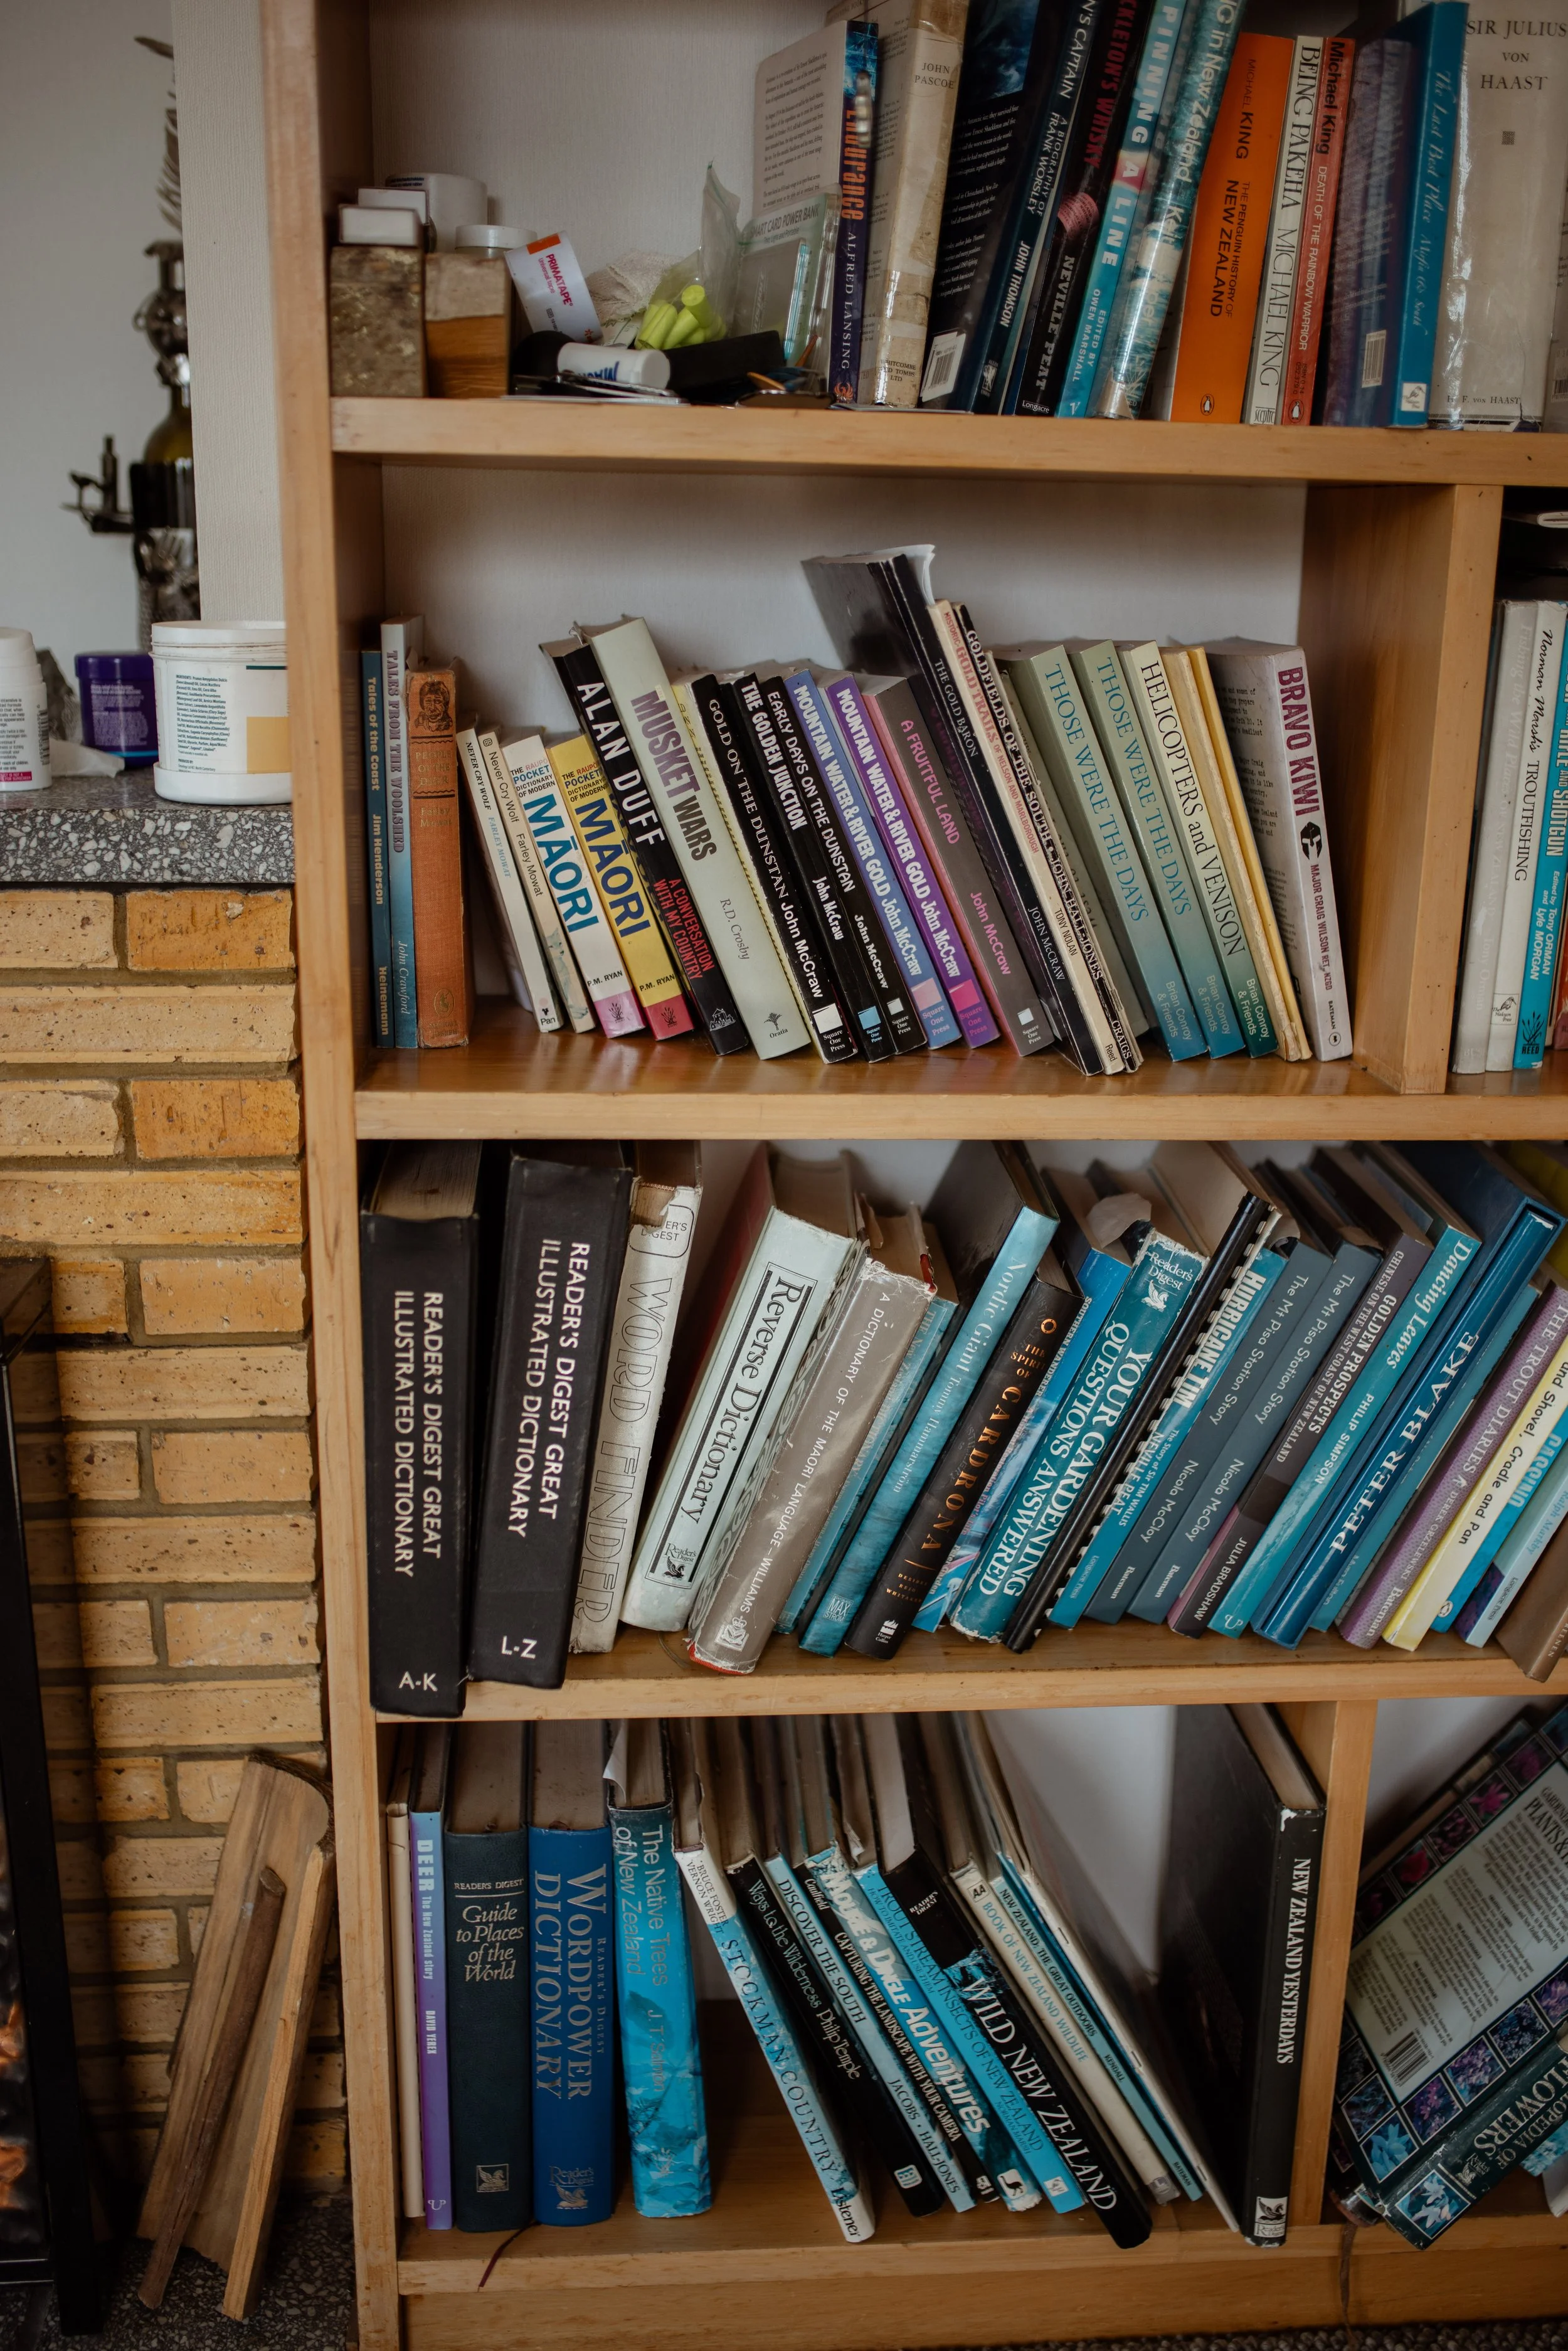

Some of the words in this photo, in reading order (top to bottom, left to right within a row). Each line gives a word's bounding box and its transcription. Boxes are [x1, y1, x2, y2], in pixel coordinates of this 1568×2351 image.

[1466, 20, 1496, 35] SIR
[1504, 20, 1567, 38] JULIUS
[922, 62, 950, 74] JOHN
[1060, 28, 1086, 98] CAPTAIN
[1131, 4, 1178, 144] PINNING
[1503, 52, 1530, 63] VON
[914, 75, 955, 89] PASCOE
[1294, 46, 1320, 115] BEING
[1480, 75, 1547, 90] HAAST
[1042, 112, 1059, 152] FRANK
[1059, 117, 1067, 125] A
[1027, 157, 1048, 213] WORSLEY
[1039, 130, 1064, 206] BIOGRAPHY
[1121, 158, 1142, 177] A
[1281, 122, 1310, 208] PAKEHA
[1315, 166, 1327, 201] DEATH
[1036, 208, 1045, 217] OF
[1222, 180, 1238, 223] NEW
[1240, 181, 1250, 201] THE
[1314, 204, 1322, 220] OF
[1102, 197, 1131, 265] LINE
[1234, 204, 1246, 252] PENGUIN
[1310, 223, 1320, 244] THE
[845, 232, 856, 294] ALFRED
[1014, 241, 1030, 272] JOHN
[1210, 228, 1232, 316] ZEALAND
[1227, 255, 1239, 301] HISTORY
[1266, 228, 1296, 323] MICHAEL
[1305, 248, 1318, 297] RAINBOW
[546, 253, 572, 305] PRIMATAPE
[1000, 274, 1022, 326] THOMSON
[1048, 255, 1074, 336] NEVILLE
[1225, 303, 1233, 317] OF
[1299, 300, 1311, 349] WARRIOR
[841, 302, 852, 368] LANSING
[1036, 341, 1055, 390] PEAT
[1259, 331, 1284, 385] KING
[1022, 400, 1050, 413] Longacre
[368, 677, 376, 711] Tales
[1278, 667, 1311, 749] BRAVO
[369, 714, 378, 727] of
[369, 730, 378, 751] the
[371, 755, 379, 790] Coast
[465, 742, 478, 768] NEVER
[474, 770, 484, 785] CRY
[480, 784, 490, 809] WOLF
[511, 766, 524, 776] THE
[513, 765, 550, 783] POCKET
[516, 775, 553, 792] DICTIONARY
[574, 676, 631, 762] ALAN
[613, 768, 667, 849] DUFF
[630, 687, 700, 802] MUSKET
[674, 795, 716, 860] WARS
[527, 780, 556, 797] MODERN
[709, 699, 731, 745] GOLD
[727, 749, 743, 774] ON
[738, 777, 757, 813] THE
[751, 816, 788, 898] DUNSTAN
[1045, 664, 1084, 744] THOSE
[1075, 744, 1110, 814] WERE
[1099, 814, 1128, 864] THE
[1116, 866, 1148, 920] DAYS
[1290, 756, 1319, 815] KIWI
[1141, 662, 1202, 815] HELICOPTERS
[1188, 822, 1215, 855] and
[1202, 856, 1245, 955] VENISON
[1515, 760, 1539, 880] TROUTFISHING
[1310, 864, 1322, 893] MAJOR
[1550, 893, 1555, 905] by
[1314, 892, 1325, 920] CRAIG
[1535, 907, 1547, 927] Lyle
[1545, 908, 1557, 932] Tony
[781, 902, 800, 938] John
[795, 942, 825, 999] McCraw
[1318, 921, 1328, 953] WILSON
[1530, 929, 1544, 980] MORGAN
[1543, 933, 1553, 975] ORMAN
[379, 966, 388, 1034] Heinemann
[587, 977, 602, 987] P.M.
[603, 970, 623, 982] RYAN
[639, 981, 655, 992] P.M.
[656, 974, 675, 987] RYAN
[541, 1017, 556, 1025] Pan
[769, 1027, 788, 1039] Oratia
[823, 1029, 843, 1041] Square
[830, 1044, 845, 1052] Press
[1522, 1045, 1540, 1054] REED
[1148, 1251, 1193, 1282] Reader's
[1148, 1266, 1183, 1290] Digest
[1333, 1274, 1354, 1295] The
[741, 1277, 804, 1378] Reverse
[1321, 1298, 1339, 1316] Mt
[1360, 1295, 1396, 1345] GOLDEN
[423, 1292, 443, 1394] READER'S
[1303, 1318, 1327, 1344] Pisa
[395, 1291, 414, 1433] ILLUSTRATED
[1277, 1347, 1310, 1389] Station
[1046, 1318, 1131, 1462] QUESTIONS
[1090, 1345, 1153, 1433] YOUR
[1255, 1393, 1283, 1424] Story
[1308, 1341, 1369, 1433] PROSPECTS
[1519, 1391, 1555, 1436] Shovel,
[423, 1403, 442, 1480] DIGEST
[683, 1384, 761, 1522] Dictionary
[1330, 1451, 1404, 1551] PETER
[1400, 1332, 1478, 1441] BLAKE
[921, 1383, 1022, 1556] CARDRONA
[1492, 1446, 1522, 1488] Cradle
[395, 1441, 413, 1575] DICTIONARY
[423, 1487, 441, 1558] GREAT
[974, 1455, 1061, 1600] ANSWERED
[1000, 1426, 1110, 1603] GARDENING
[1475, 1494, 1492, 1518] and
[1458, 1522, 1479, 1544] Pan
[501, 1635, 538, 1659] L-Z
[398, 1671, 438, 1691] A-K
[453, 1882, 492, 1891] READER'S
[495, 1878, 524, 1889] DIGEST
[1291, 1859, 1310, 1894] NEW
[456, 1926, 472, 1943] to
[474, 1923, 524, 1943] Places
[462, 1903, 518, 1924] Guide
[1285, 1897, 1306, 1968] ZEALAND
[465, 1962, 516, 1982] World
[468, 1946, 485, 1965] of
[487, 1943, 514, 1961] the
[777, 1879, 822, 1947] DISCOVER
[817, 1948, 839, 1976] THE
[832, 1977, 866, 2022] SOUTH
[535, 1871, 561, 2097] DICTIONARY
[566, 1865, 607, 2099] WORDPOWER
[982, 1902, 1006, 1933] BOOK
[1002, 1934, 1015, 1947] OF
[1012, 1949, 1032, 1972] NEW
[1027, 1976, 1059, 2017] ZEALAND
[1056, 2018, 1088, 2061] WILDLIFE
[1277, 1967, 1300, 2062] YESTERDAYS
[719, 1936, 790, 2067] STOCKMAN
[779, 2069, 839, 2178] COUNTRY
[961, 1973, 1017, 2047] WILD
[1004, 2043, 1052, 2106] NEW
[1039, 2099, 1119, 2216] ZEALAND
